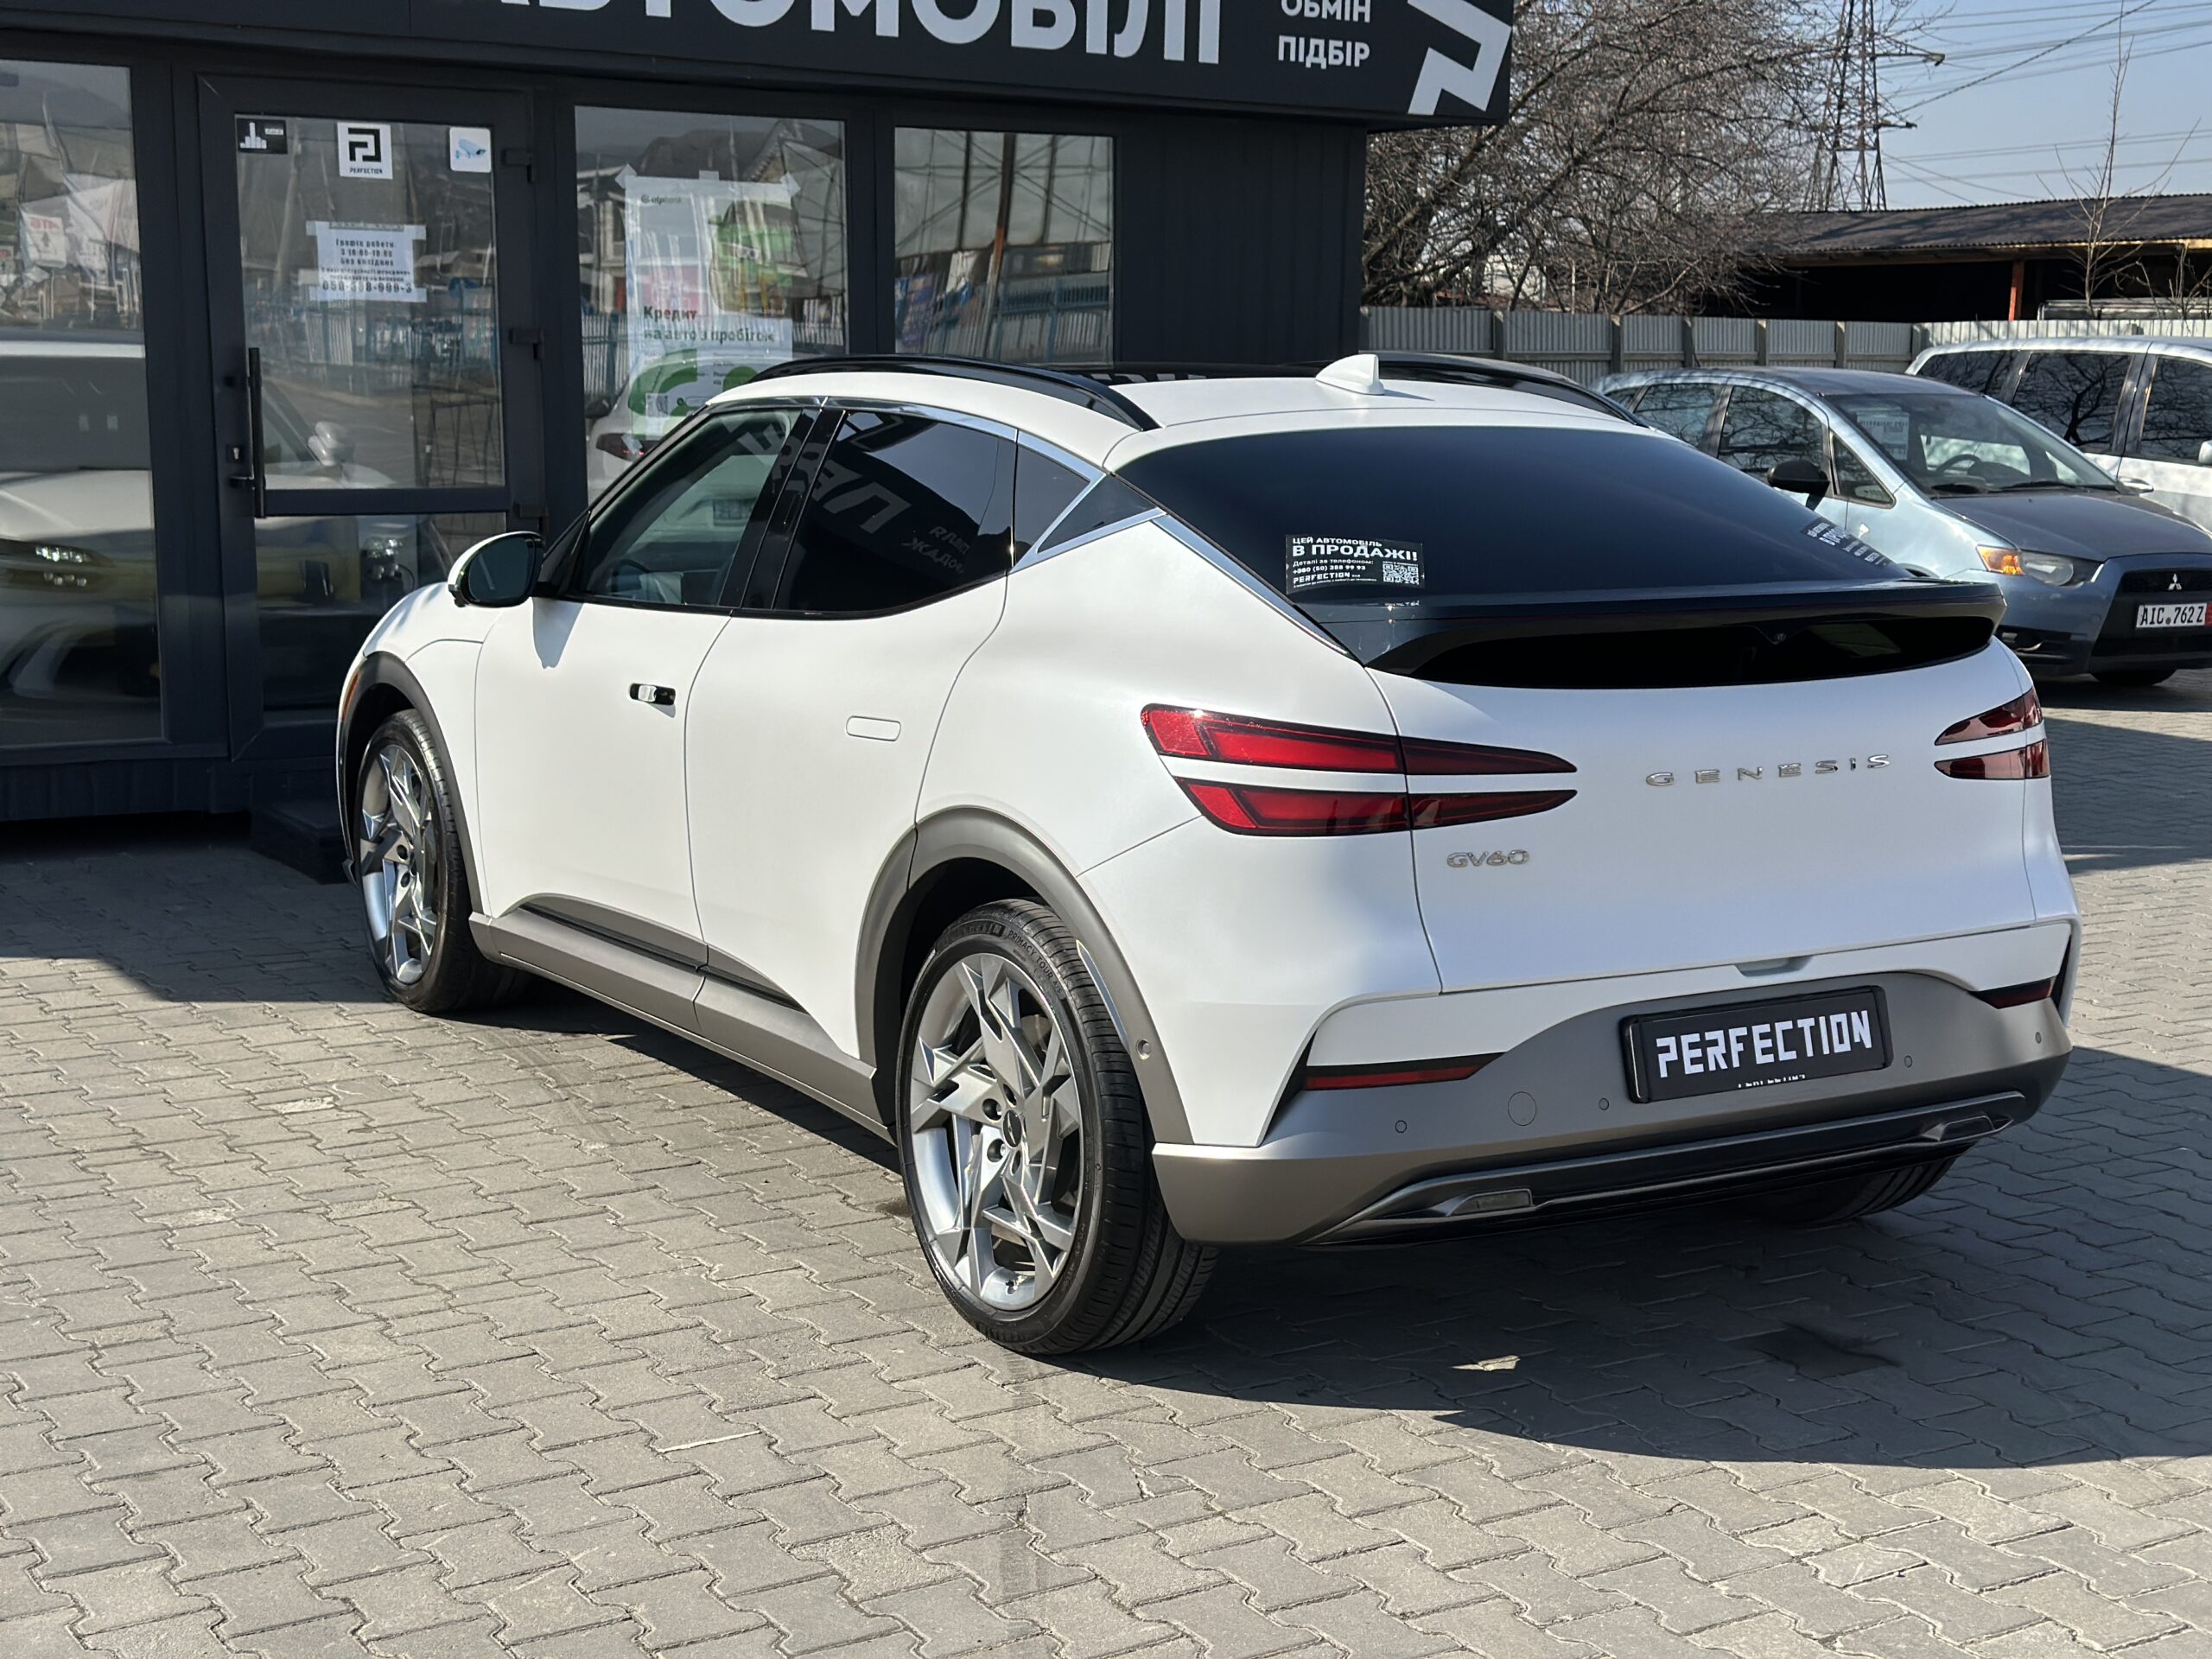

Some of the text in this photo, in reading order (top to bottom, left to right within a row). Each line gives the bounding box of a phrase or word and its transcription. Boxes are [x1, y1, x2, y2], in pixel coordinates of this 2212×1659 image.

[1281, 0, 1371, 23] ОБМІН
[501, 0, 1221, 64] ОБІЛІ
[1278, 35, 1370, 69] ПІДБІР
[644, 306, 697, 323] Кредит
[1293, 545, 1305, 556] В
[1316, 537, 1382, 547] АВТОМОБІЛЬ
[1293, 559, 1318, 568] Деталі
[1293, 572, 1351, 584] PERFECTION
[2139, 607, 2164, 626] AIC
[1645, 753, 1891, 788] GENESIS
[1446, 849, 1530, 868] GV60
[1007, 930, 1037, 956] PRIMACY
[1036, 957, 1054, 980] TOUR
[1656, 1009, 1873, 1078] PERFECTION
